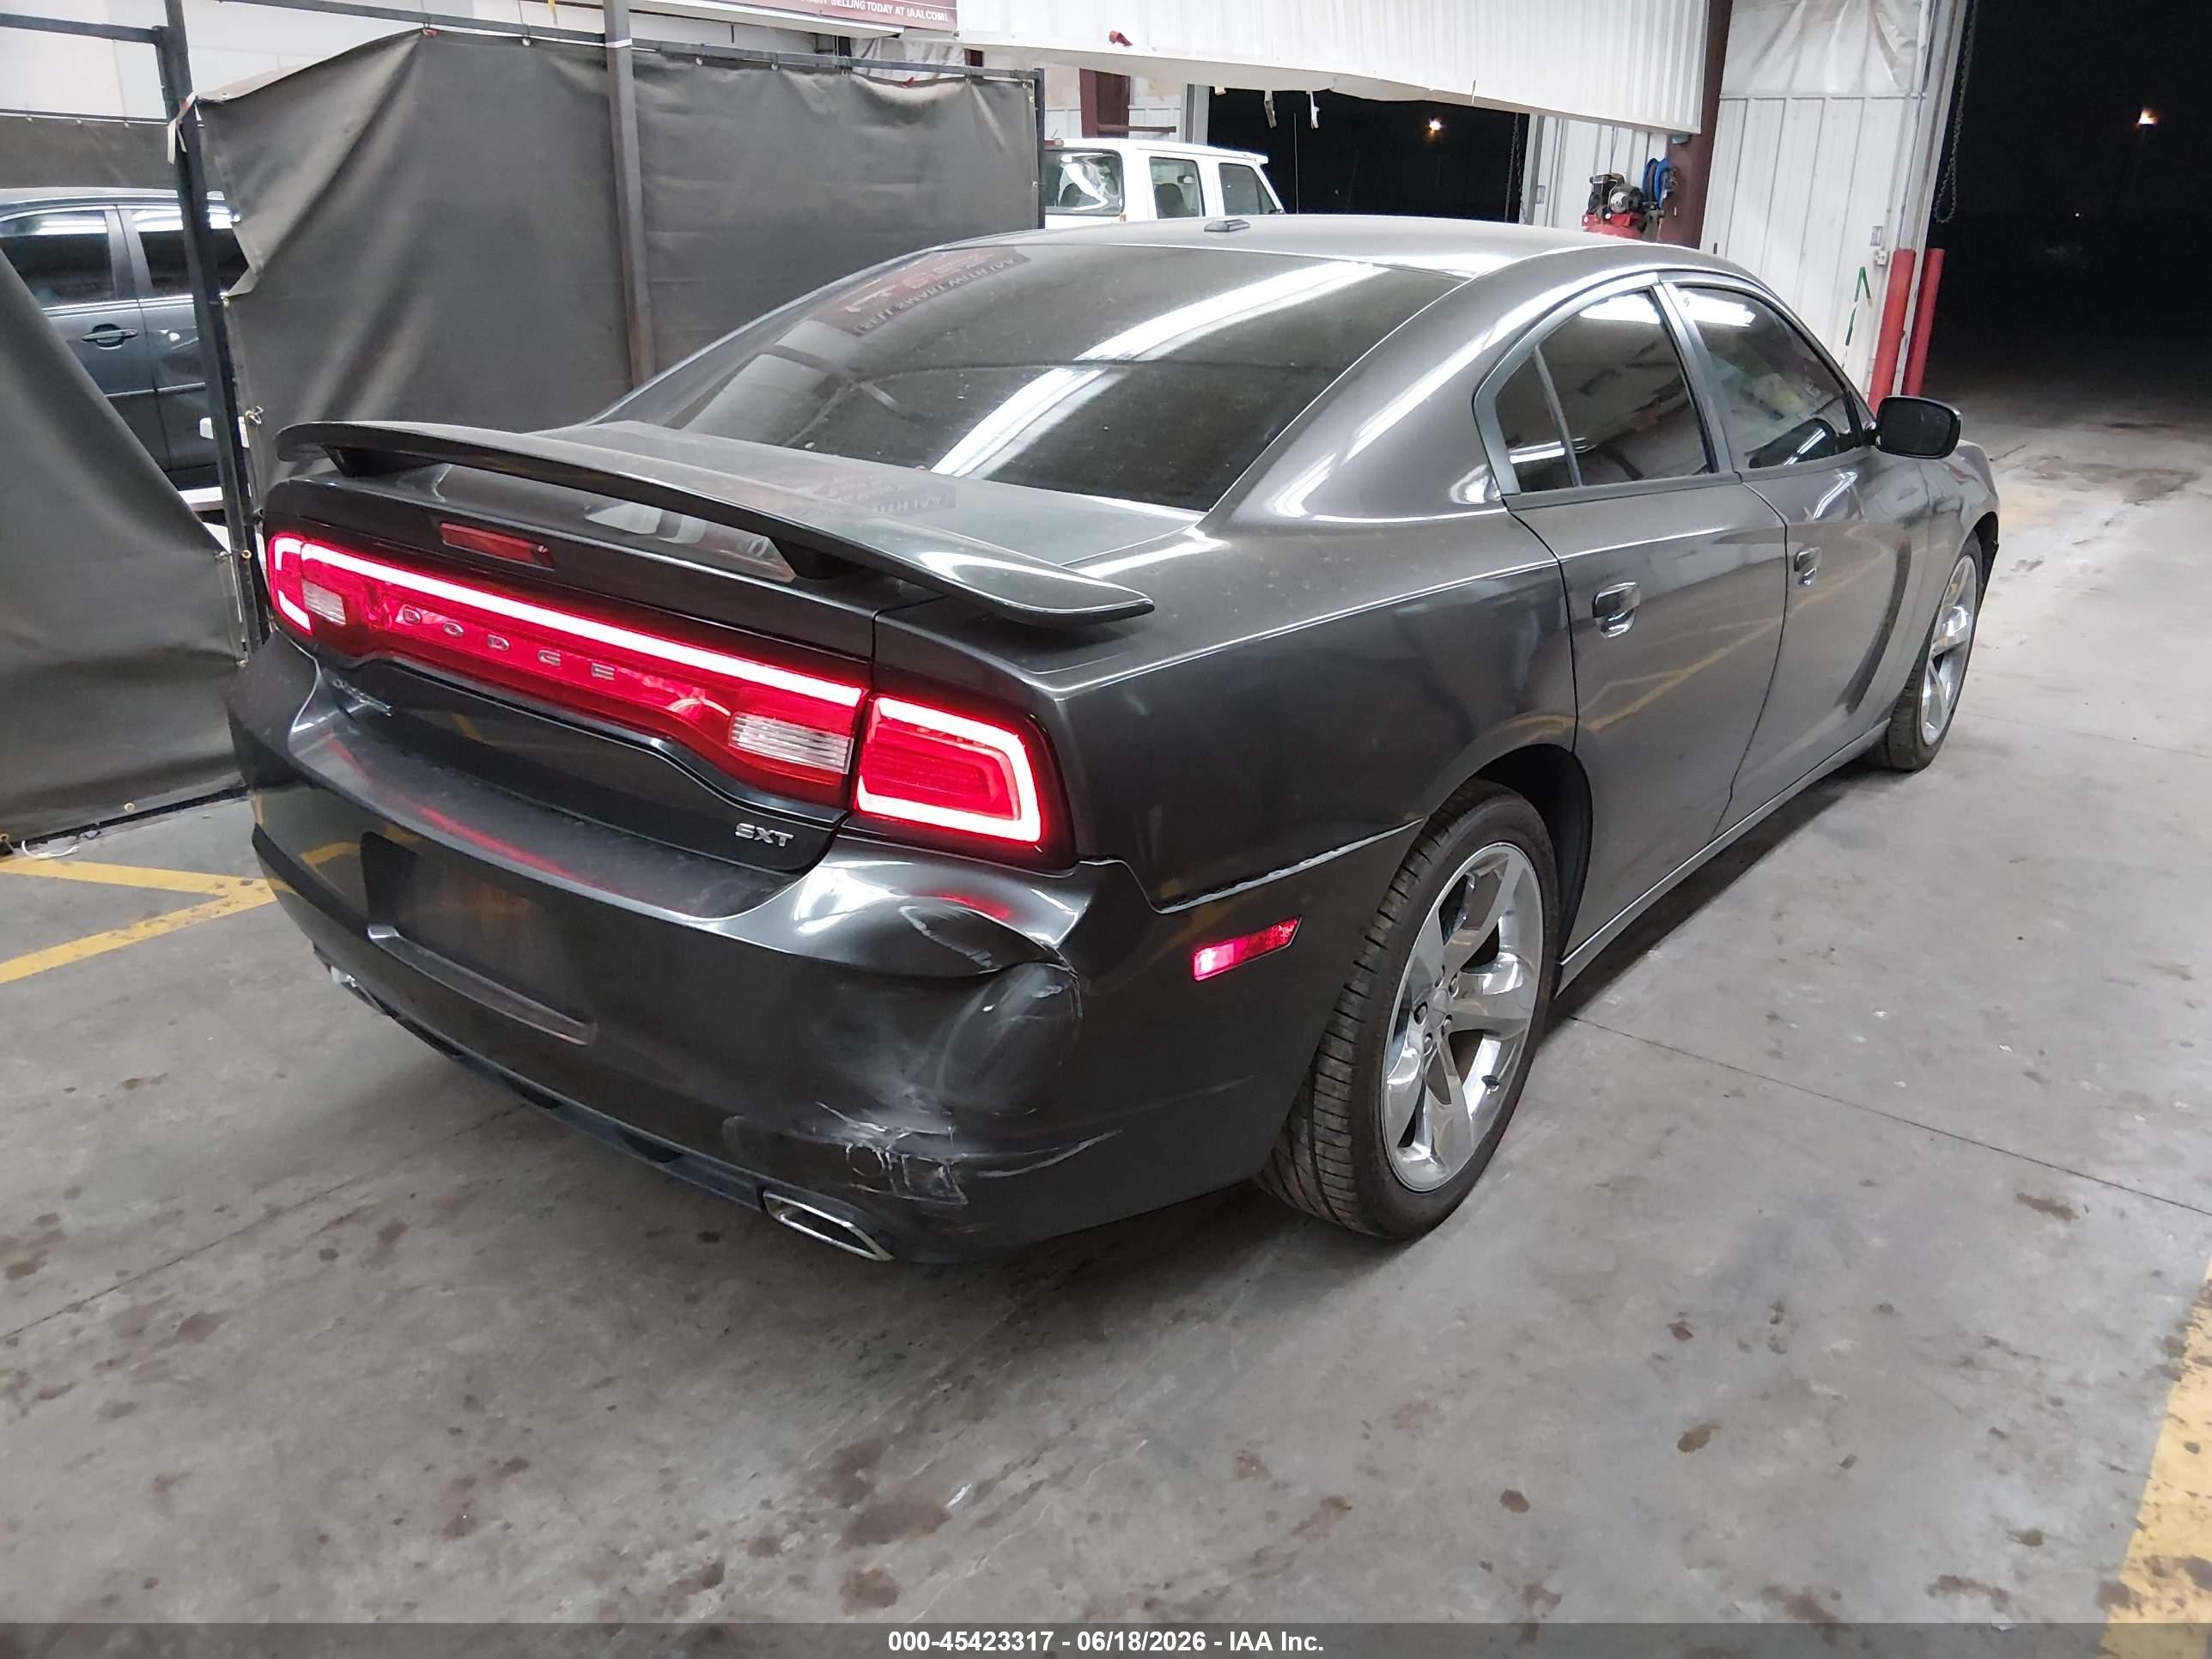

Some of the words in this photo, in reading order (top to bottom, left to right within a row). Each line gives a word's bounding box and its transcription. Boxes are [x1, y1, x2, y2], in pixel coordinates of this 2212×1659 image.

[866, 2, 893, 15] TODAY
[895, 6, 905, 15] AT
[402, 608, 617, 681] DODGE
[734, 822, 795, 848] SXT
